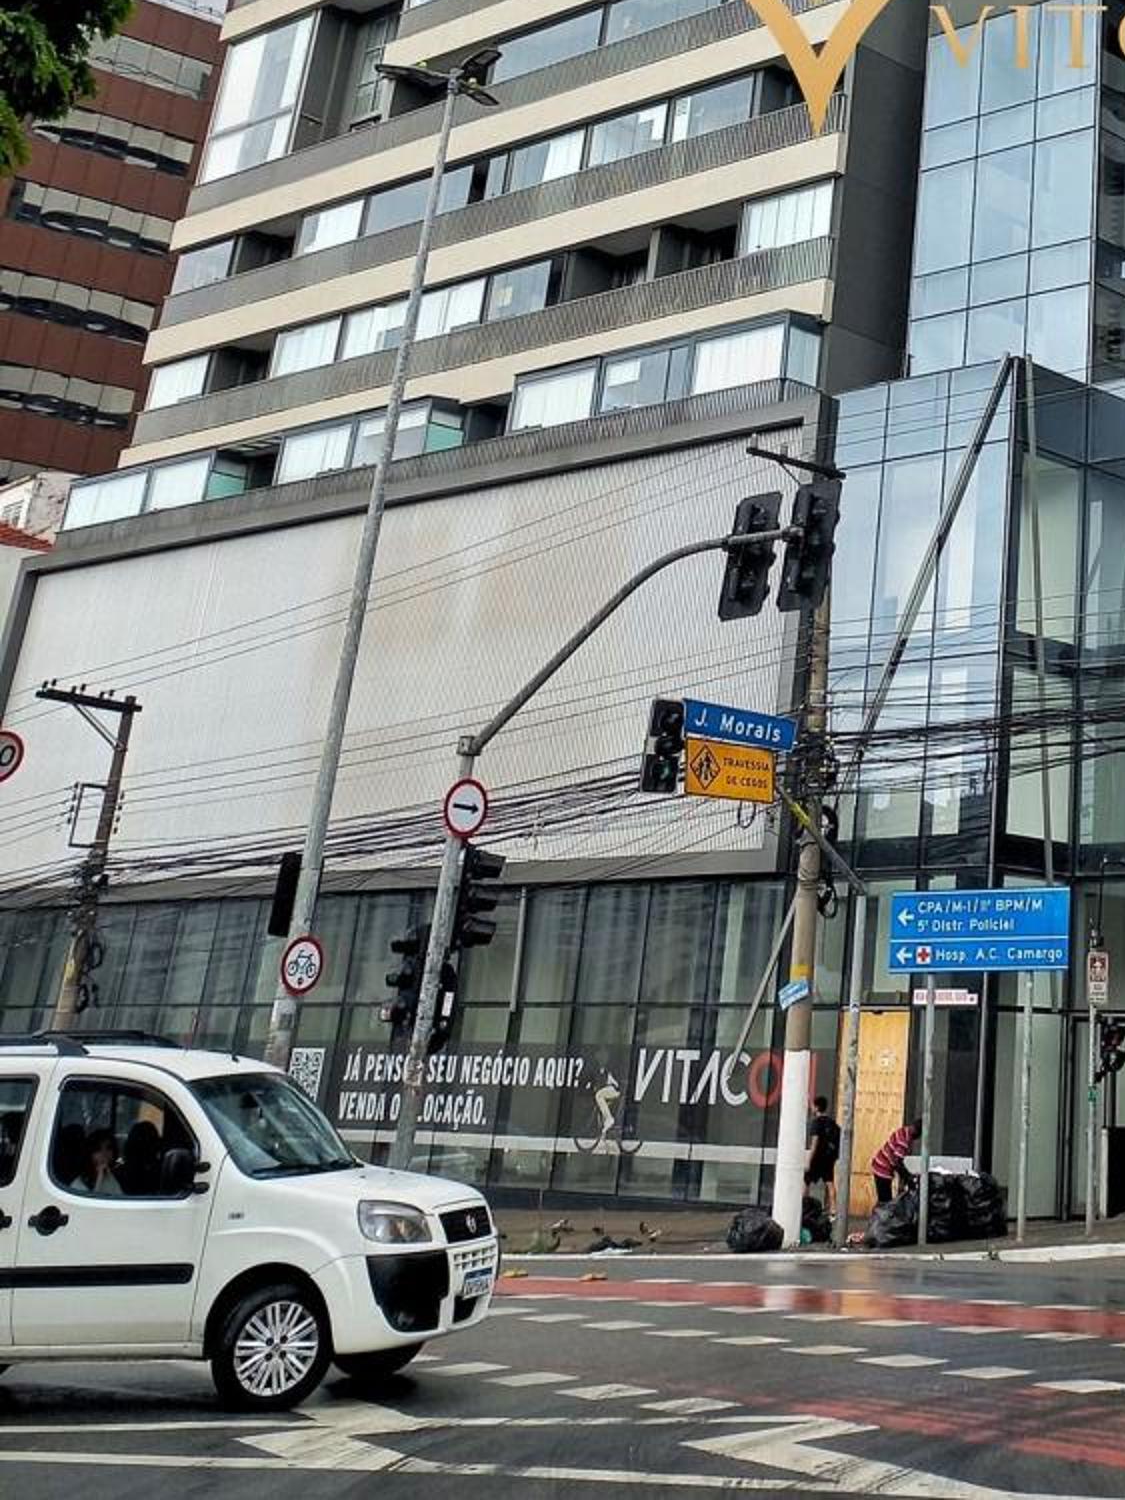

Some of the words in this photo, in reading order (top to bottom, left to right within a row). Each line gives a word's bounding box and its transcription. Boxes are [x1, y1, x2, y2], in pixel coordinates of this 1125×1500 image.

[694, 707, 709, 728] J.
[719, 713, 782, 742] Morais
[1007, 947, 1063, 963] Camargo
[343, 1047, 361, 1082] JÁ
[426, 1054, 458, 1084] SEU
[459, 1049, 530, 1086] NEGÓCIO
[338, 1092, 386, 1121] VENDA
[417, 1089, 487, 1130] OCAÇÃO.
